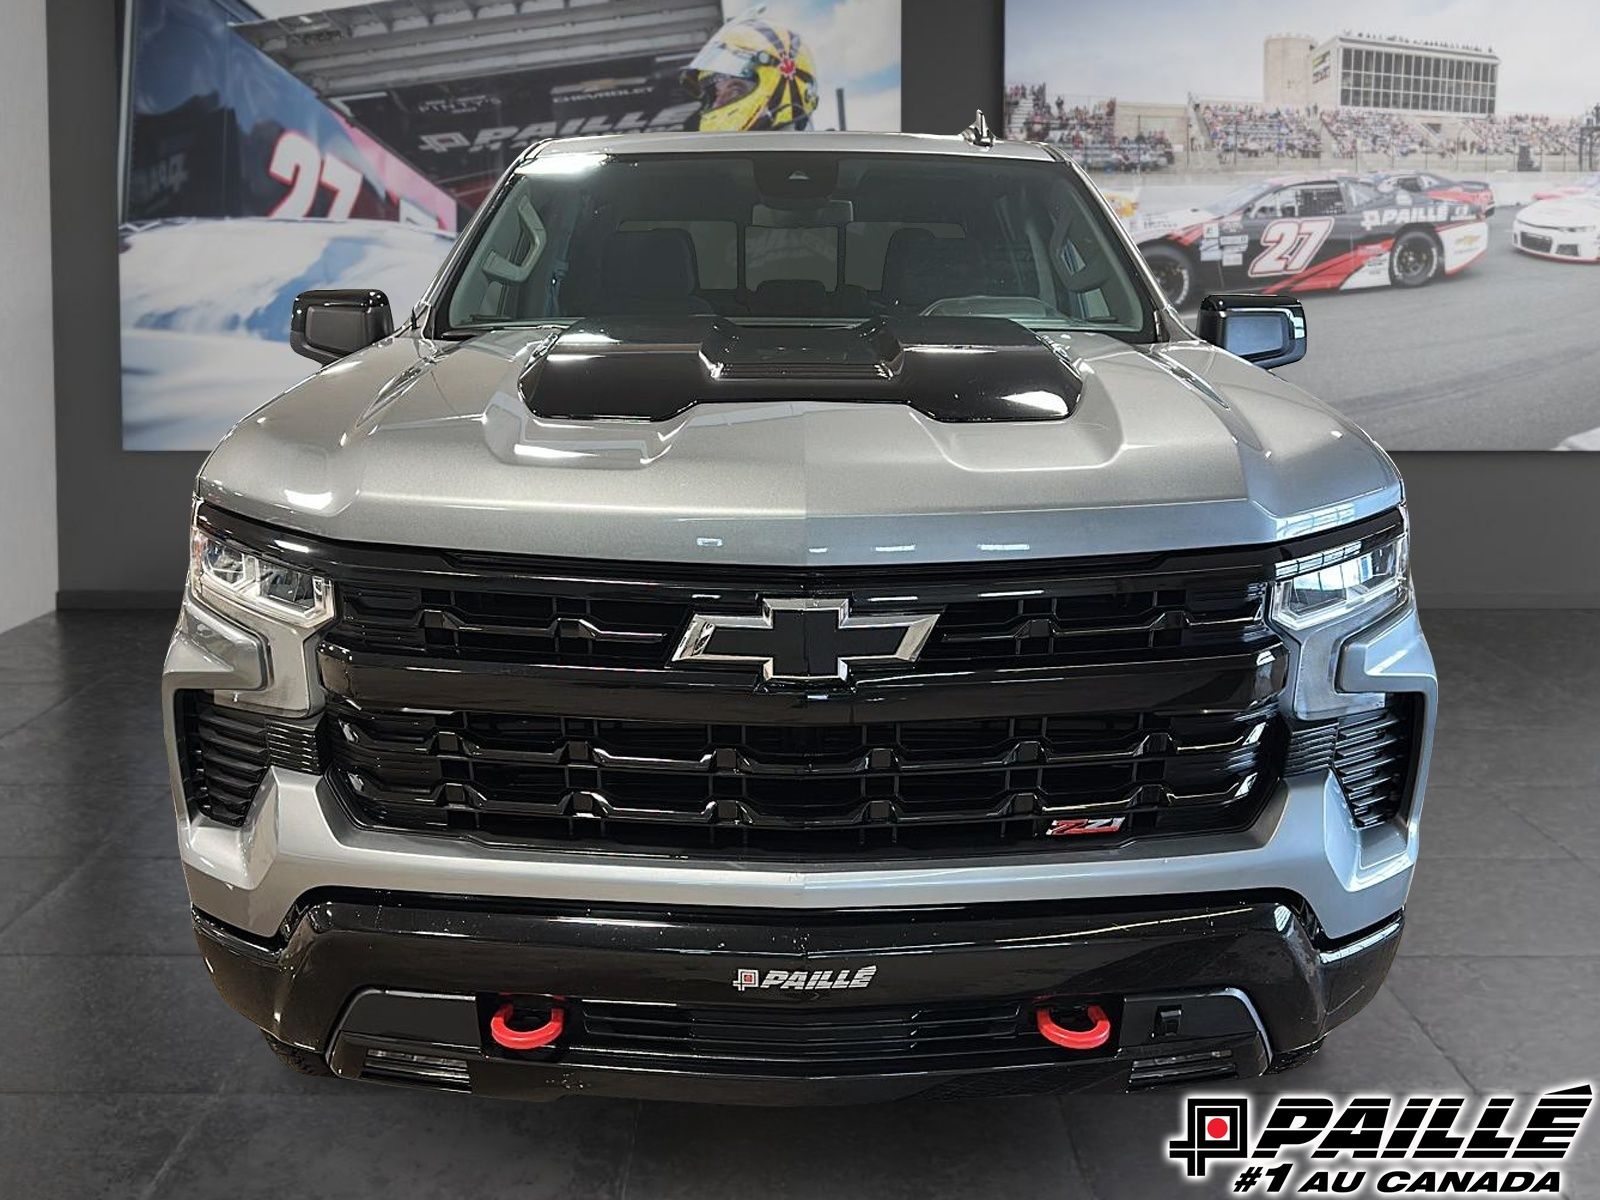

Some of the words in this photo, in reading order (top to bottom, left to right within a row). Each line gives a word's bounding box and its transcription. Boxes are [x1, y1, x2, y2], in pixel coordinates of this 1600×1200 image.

[553, 86, 655, 103] CHEVROLET
[268, 130, 362, 221] 27
[1248, 217, 1335, 277] 27
[760, 965, 877, 990] PAILLÉ
